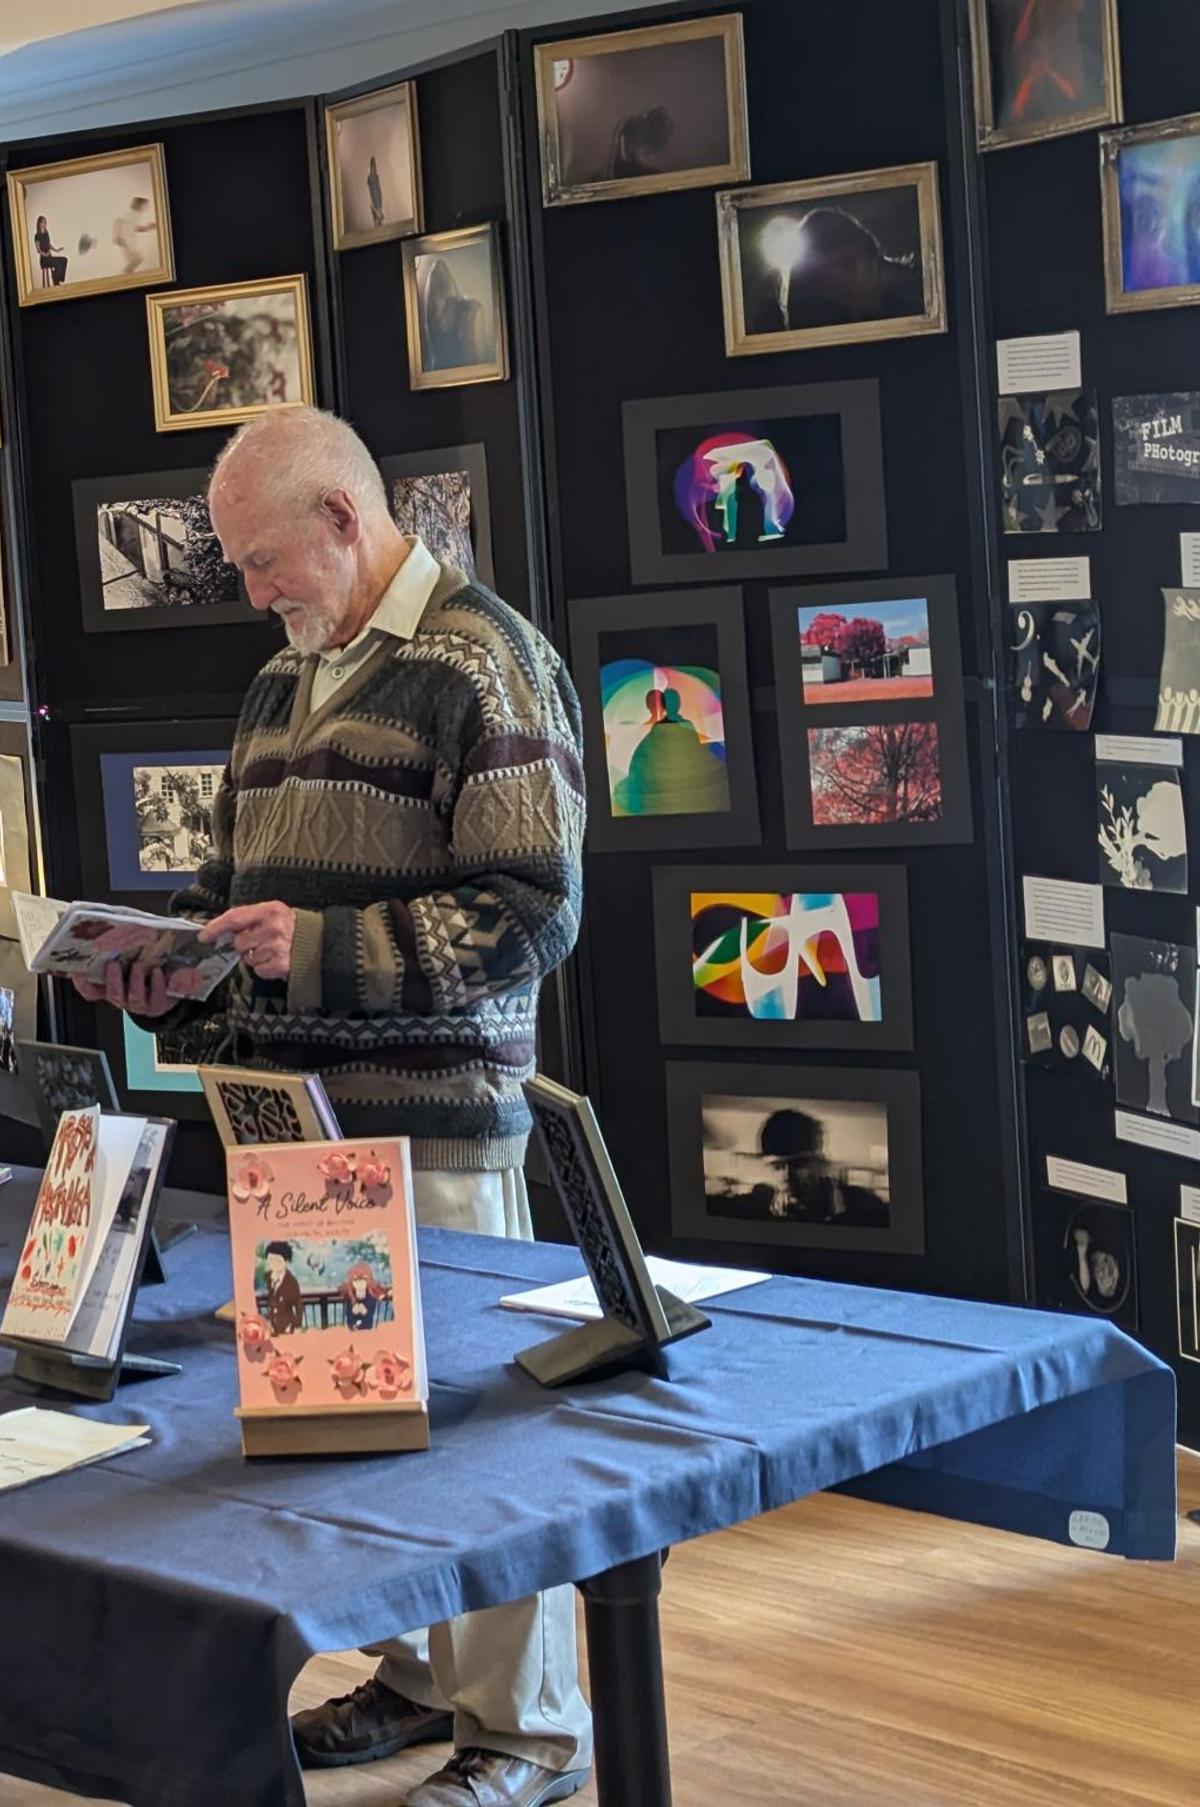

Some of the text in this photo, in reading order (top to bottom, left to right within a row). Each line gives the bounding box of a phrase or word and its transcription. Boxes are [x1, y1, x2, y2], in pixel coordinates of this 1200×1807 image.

[1140, 414, 1183, 441] FILM
[256, 1193, 272, 1221] A
[276, 1191, 329, 1219] Silent
